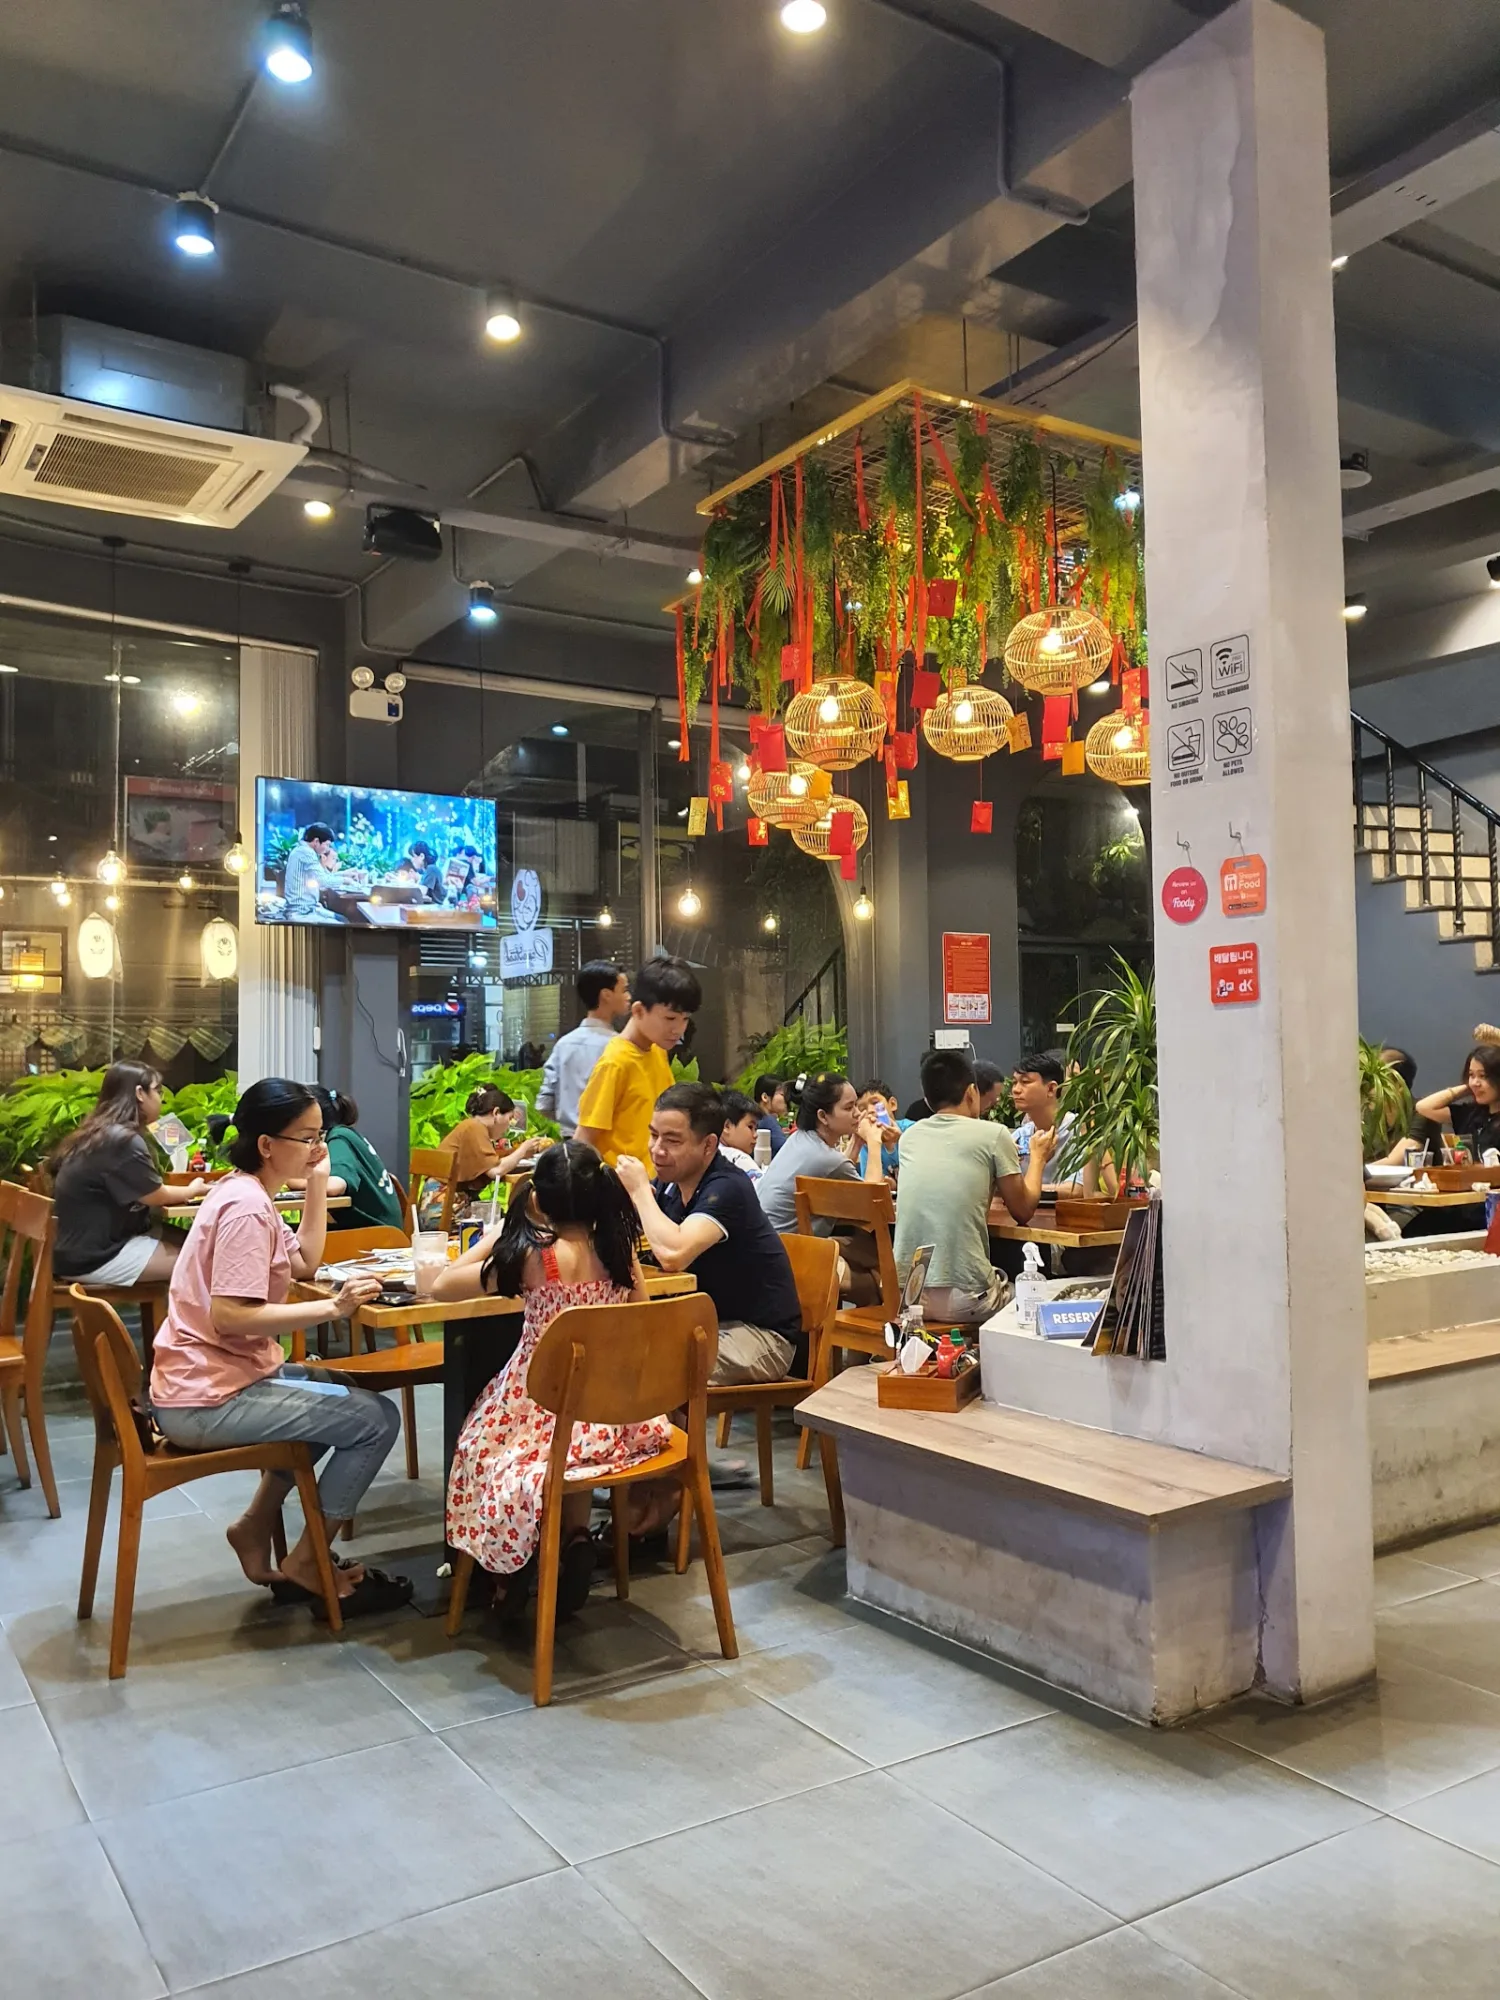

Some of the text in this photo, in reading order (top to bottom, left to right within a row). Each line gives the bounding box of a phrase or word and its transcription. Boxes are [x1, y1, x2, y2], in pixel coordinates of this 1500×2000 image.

[1218, 660, 1243, 677] WiFi
[1231, 758, 1243, 767] PETS
[1181, 768, 1199, 778] OUTSIDE
[1222, 766, 1245, 777] ALLOWED
[1170, 780, 1181, 788] FOOD
[1238, 877, 1260, 889] Food
[1172, 896, 1195, 911] Foody
[1052, 1312, 1099, 1324] RESERV
